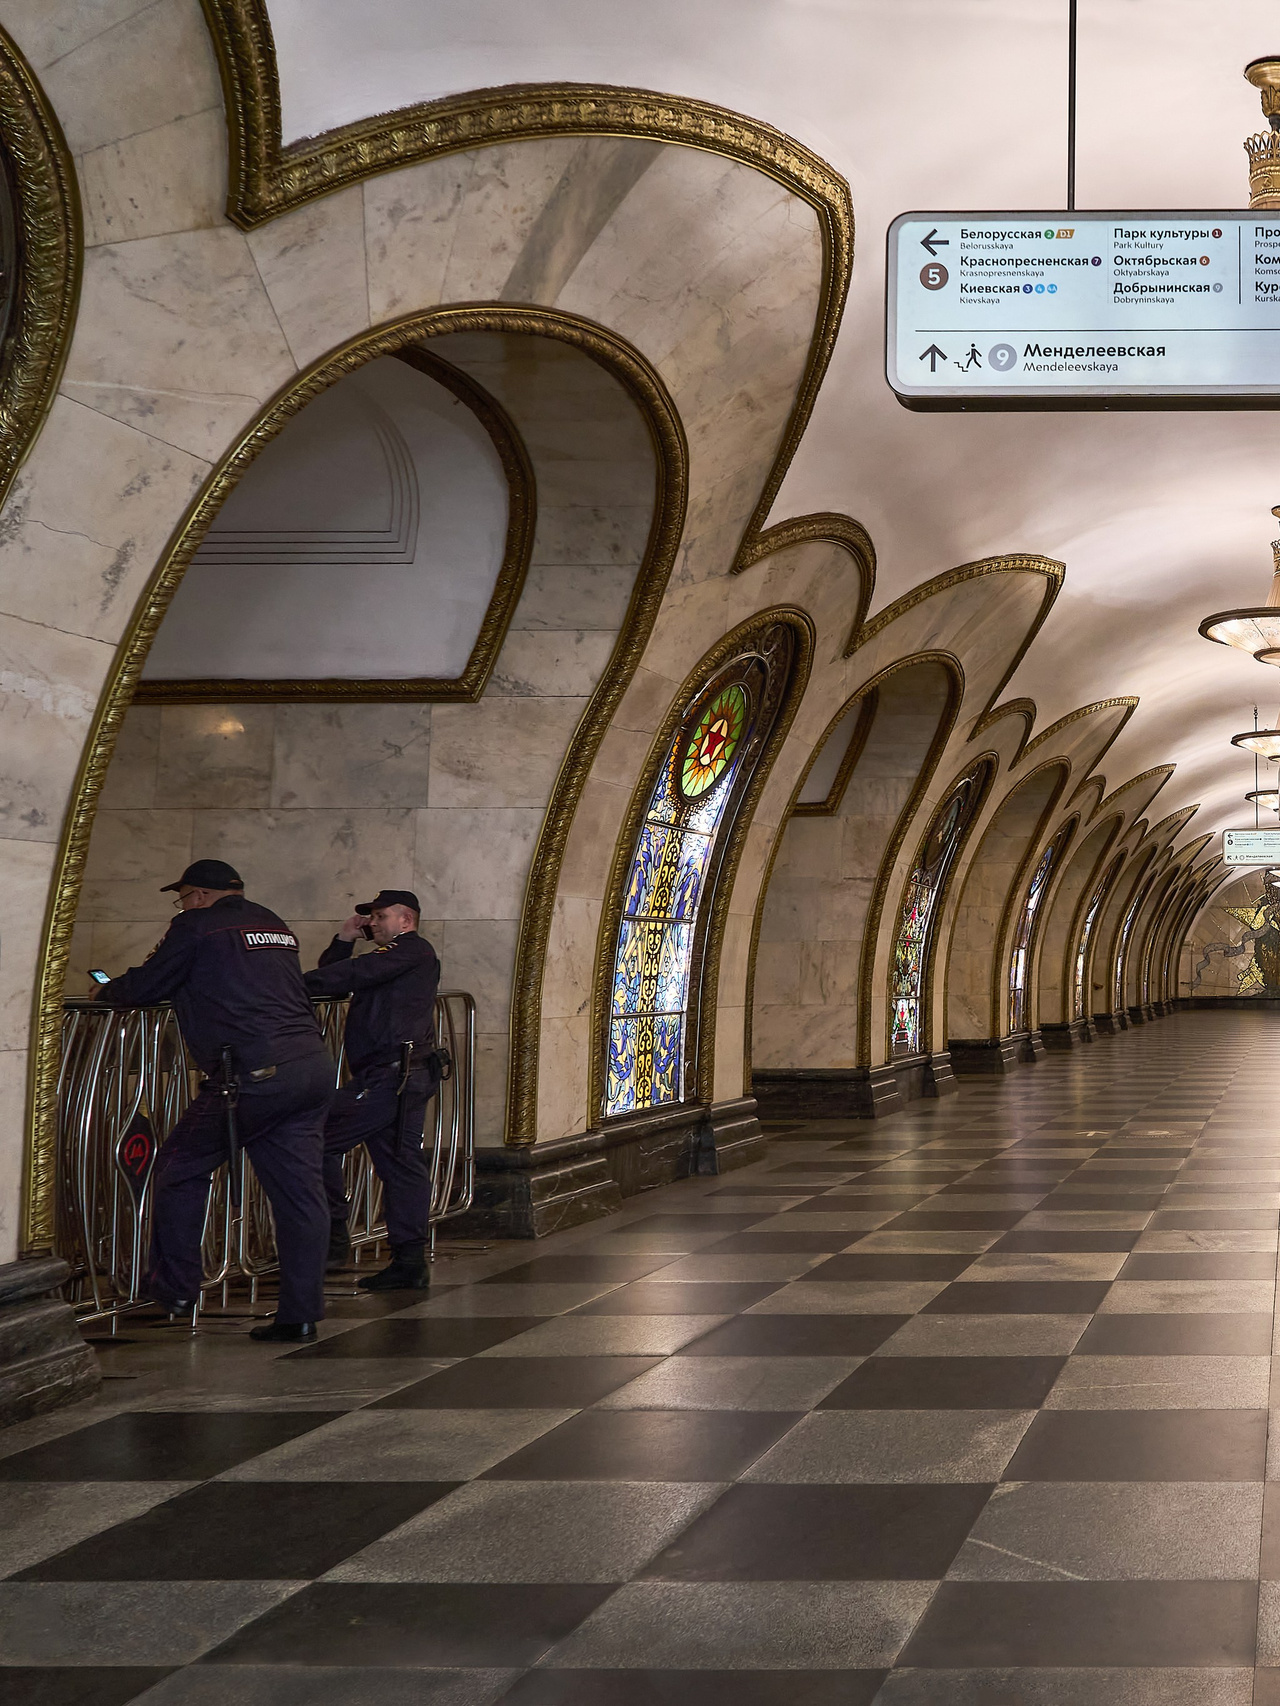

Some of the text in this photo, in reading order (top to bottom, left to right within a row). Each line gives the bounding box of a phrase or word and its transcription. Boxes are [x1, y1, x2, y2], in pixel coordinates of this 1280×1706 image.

[961, 229, 1041, 241] Белорусская
[1114, 228, 1146, 240] Парк
[1150, 230, 1209, 241] культуры
[960, 242, 1013, 250] Belorusskaya
[1134, 242, 1163, 250] Kultury
[961, 256, 1088, 268] Краснопресненская
[1114, 255, 1197, 268] Октябрьская
[928, 269, 940, 285] 5
[960, 269, 1044, 278] Krasnopresnenskaya
[1114, 269, 1169, 277] Oktyabrskaya
[961, 283, 1020, 293] Киевская
[1114, 282, 1210, 295] Добрынинская
[960, 297, 1000, 305] Kievskaya
[1114, 296, 1174, 304] Dobryninskaya
[997, 344, 1165, 366] 9 Менделеевская
[1023, 361, 1118, 373] Mendeleevskaya
[245, 933, 297, 946] ПОЛИЦИЯ
